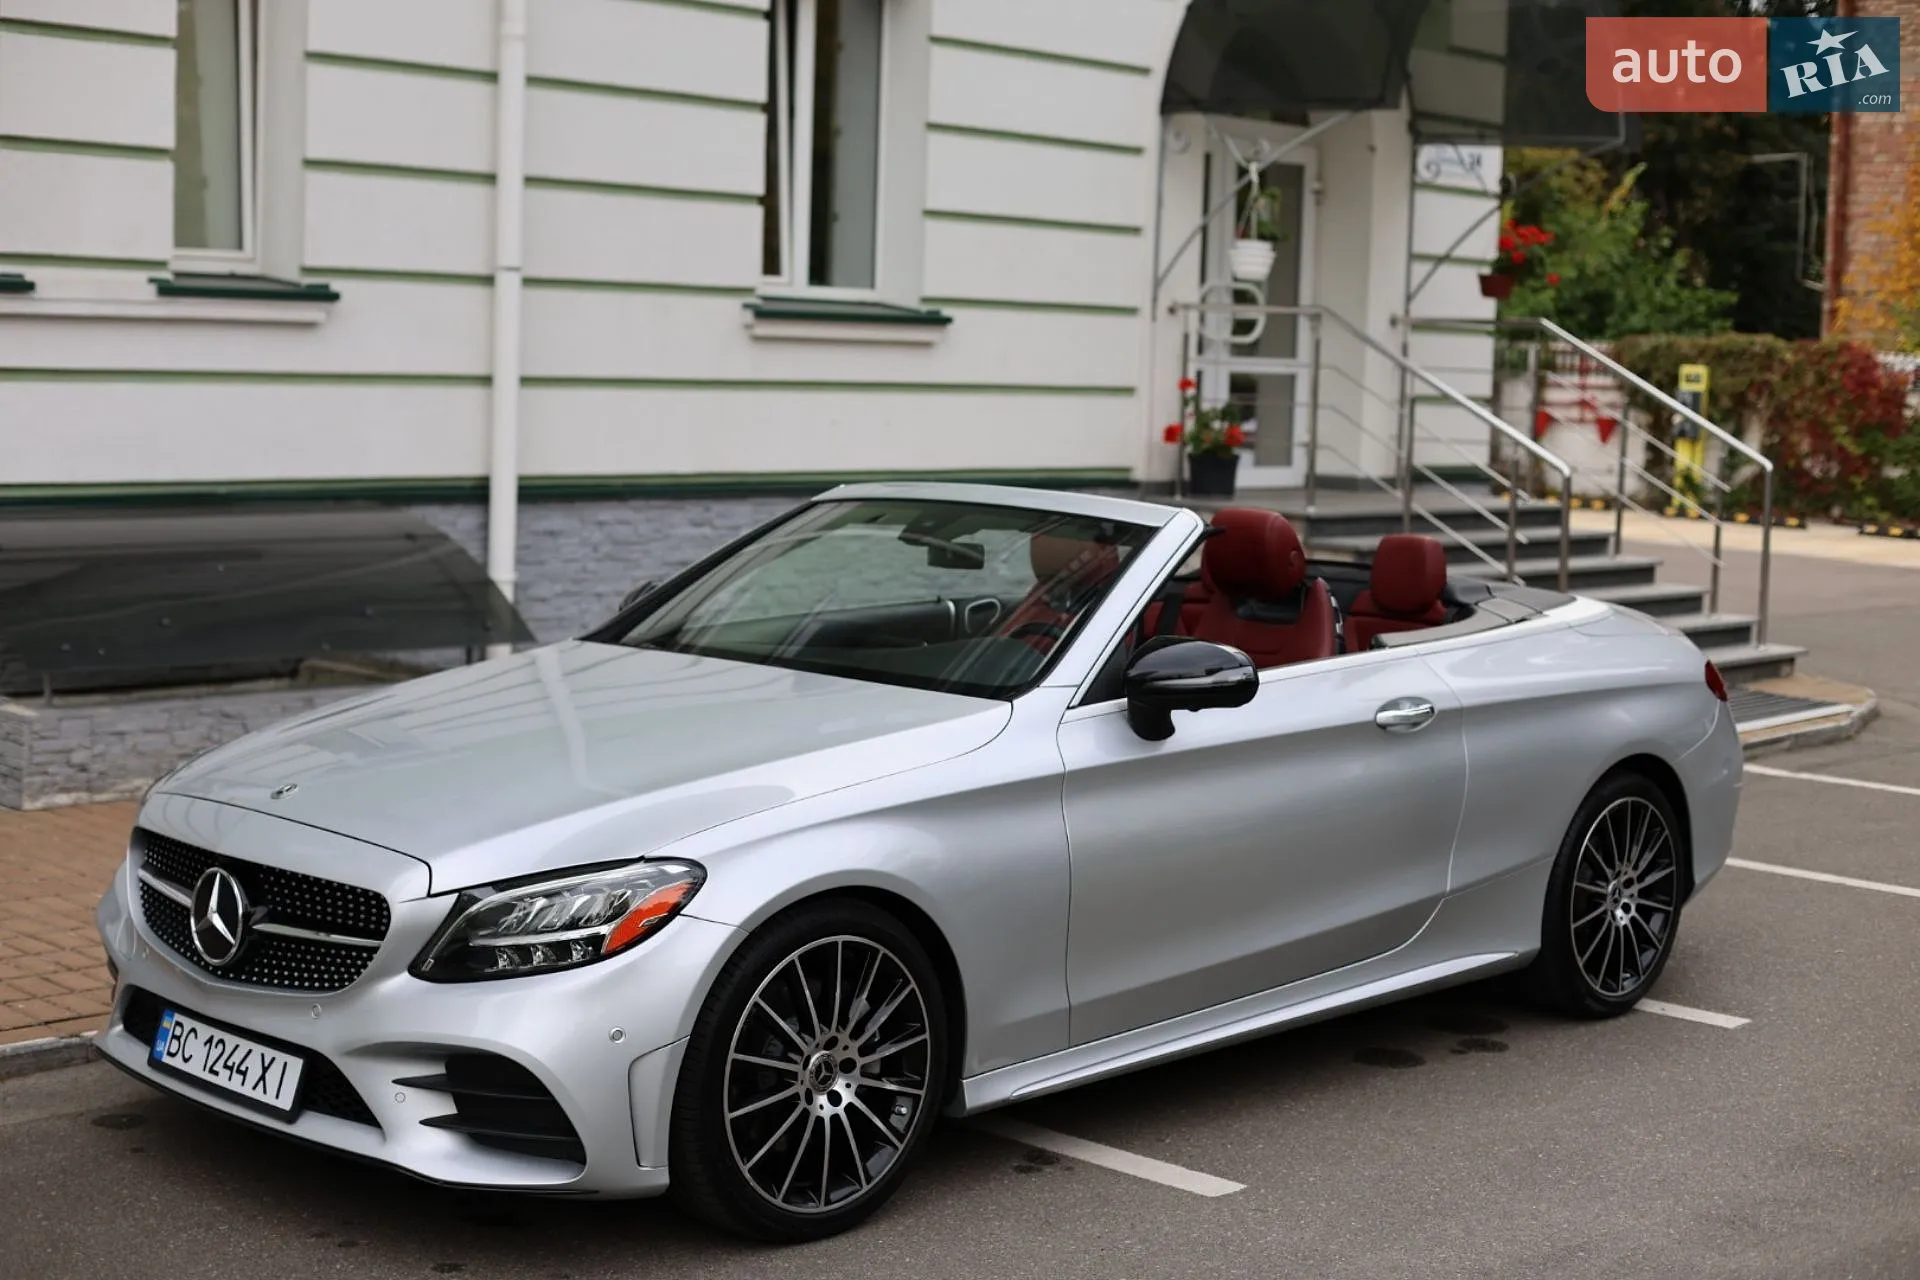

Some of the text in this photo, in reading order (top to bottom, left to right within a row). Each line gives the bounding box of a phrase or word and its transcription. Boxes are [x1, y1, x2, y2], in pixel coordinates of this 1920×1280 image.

[166, 1020, 288, 1100] BC 1244 XI
